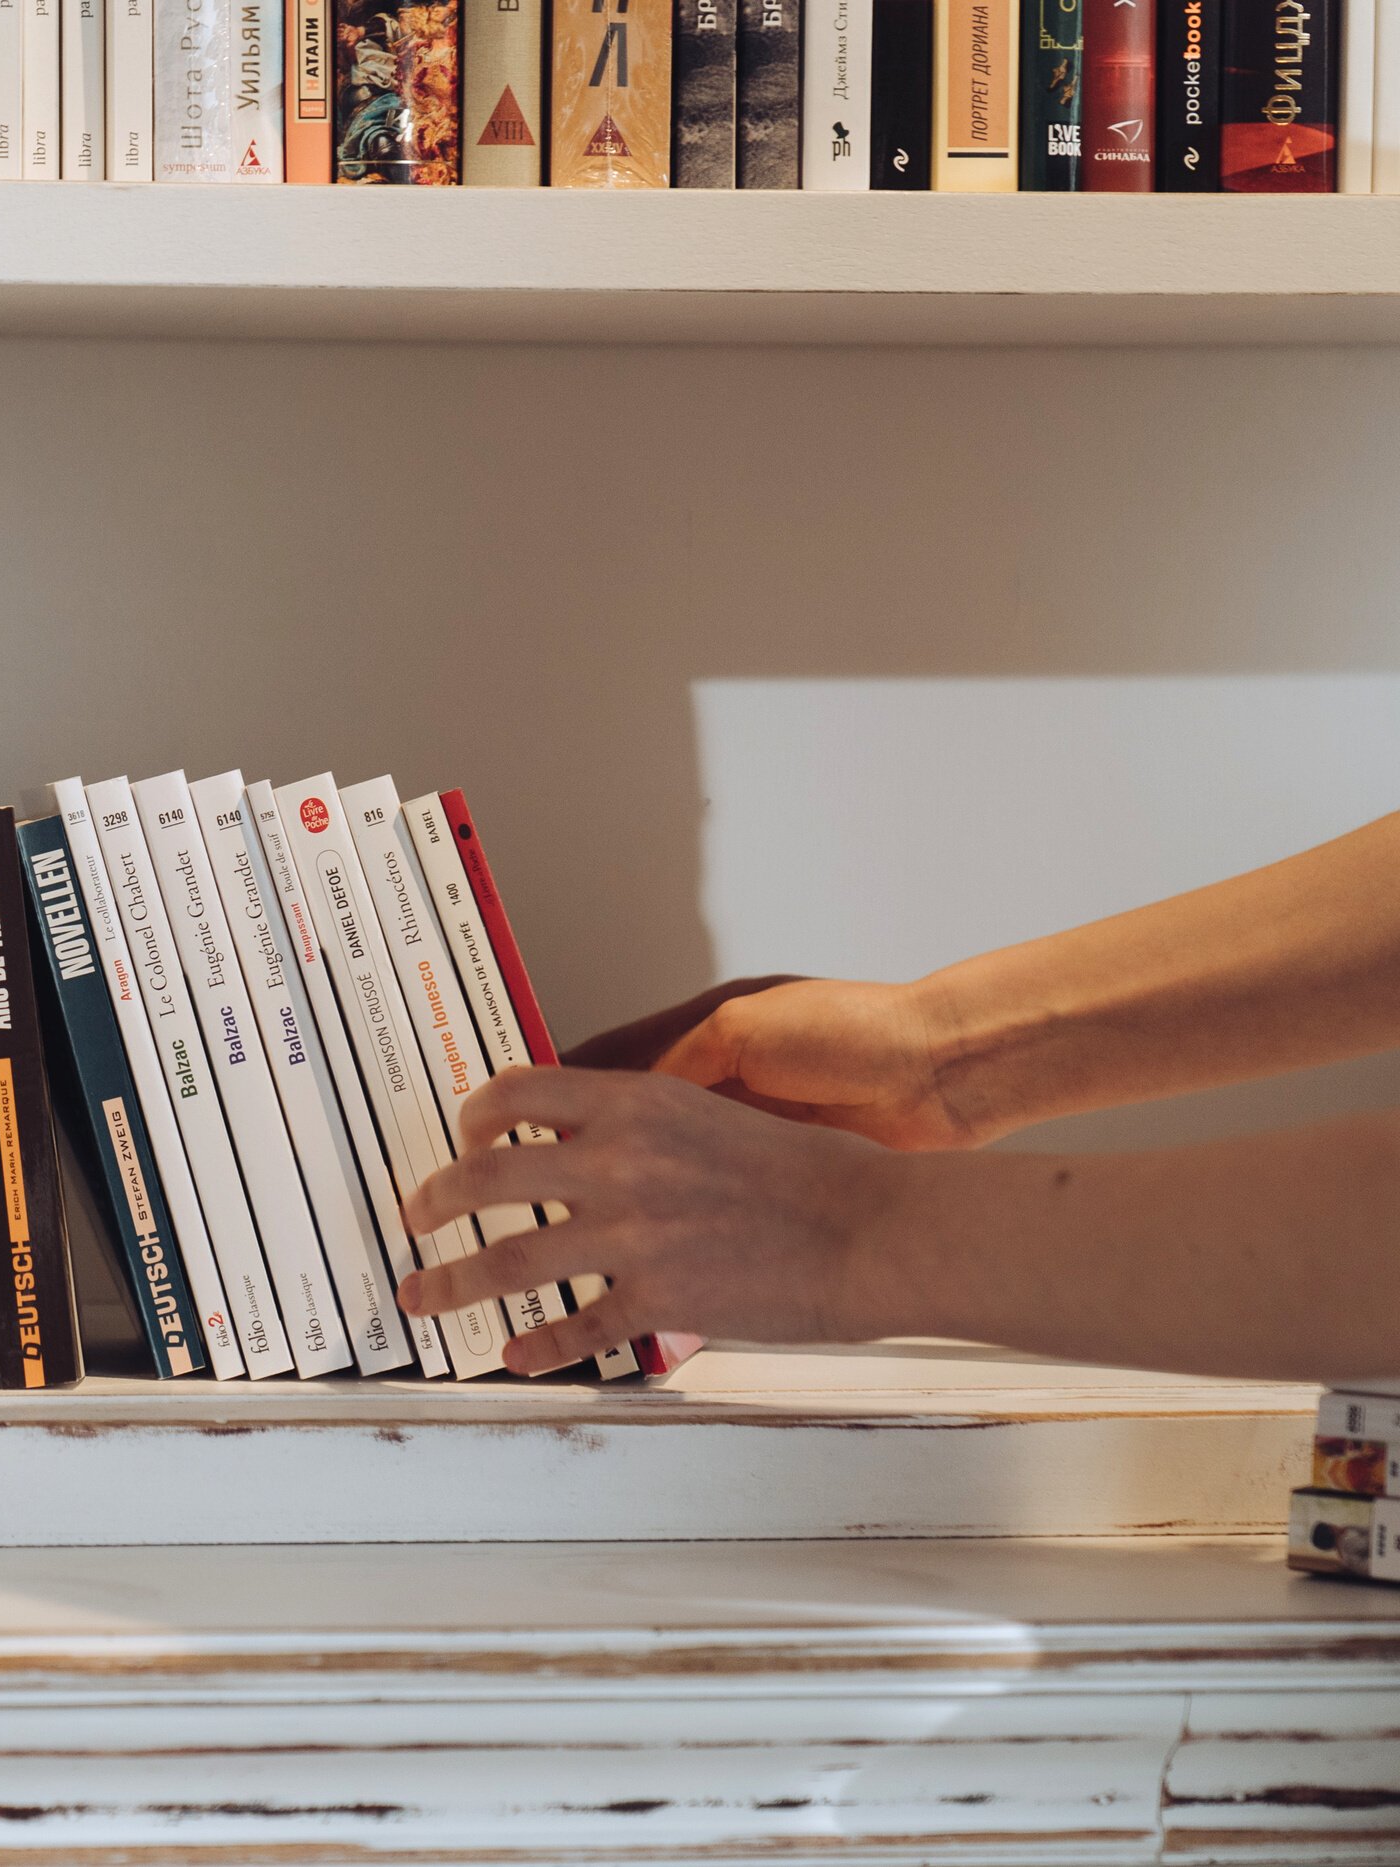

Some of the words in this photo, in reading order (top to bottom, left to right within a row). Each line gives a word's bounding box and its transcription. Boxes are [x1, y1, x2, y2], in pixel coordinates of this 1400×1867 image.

[236, 6, 260, 110] Уильям
[306, 18, 318, 90] НАТАЛИ
[972, 6, 991, 76] ДОРИАНА
[833, 36, 848, 99] Джеймз
[181, 68, 202, 148] Шота
[972, 79, 988, 141] ПОРТРЕТ
[33, 131, 46, 165] libra
[489, 121, 524, 140] VIII
[1048, 142, 1081, 156] BOOK
[1049, 124, 1081, 142] LIVE
[1094, 153, 1150, 162] СИНДБАД
[1271, 165, 1305, 173] АЗБУКА
[103, 811, 128, 827] 3298
[158, 809, 184, 824] 6140
[260, 810, 275, 820] 5752
[302, 806, 324, 818] Livre
[304, 818, 328, 830] Poche
[364, 808, 383, 823] 816
[421, 809, 440, 843] BABEL
[268, 833, 284, 851] suif
[85, 855, 113, 928] collaborateur
[120, 852, 148, 921] Chabert
[175, 850, 204, 918] Grandet
[278, 863, 294, 892] Boule
[326, 867, 348, 909] DEFOE
[383, 852, 422, 946] Rhinocéros
[446, 883, 462, 906] 1400
[30, 848, 96, 980] NOVELLEN
[290, 903, 315, 963] Maupassant
[342, 913, 364, 959] DANIEL
[135, 926, 167, 991] Colonel
[194, 922, 226, 989] Eugénie
[459, 921, 479, 965] POUPÉE
[113, 959, 132, 1001] Aragon
[418, 960, 448, 1029] Ionesco
[475, 964, 486, 981] DE
[158, 994, 176, 1018] Le
[357, 972, 384, 1022] CRUSOÉ
[481, 982, 503, 1026] MAISON
[219, 1006, 247, 1066] Balzac
[496, 1027, 511, 1053] UNE
[171, 1039, 198, 1099] Balzac
[375, 1026, 406, 1092] ROBINSON
[441, 1032, 470, 1096] Eugène
[0, 1079, 14, 1148] REMARQUE
[112, 1111, 132, 1161] ZWEIG
[8, 1151, 19, 1186] MARIA
[14, 1188, 22, 1221] ERICH
[128, 1168, 147, 1221] STEFAN
[11, 1241, 42, 1361] DEUTSCH
[137, 1231, 184, 1347] DEUTSCH
[243, 1275, 260, 1318] classique
[250, 1320, 270, 1354] folio
[467, 1311, 481, 1336] 16115
